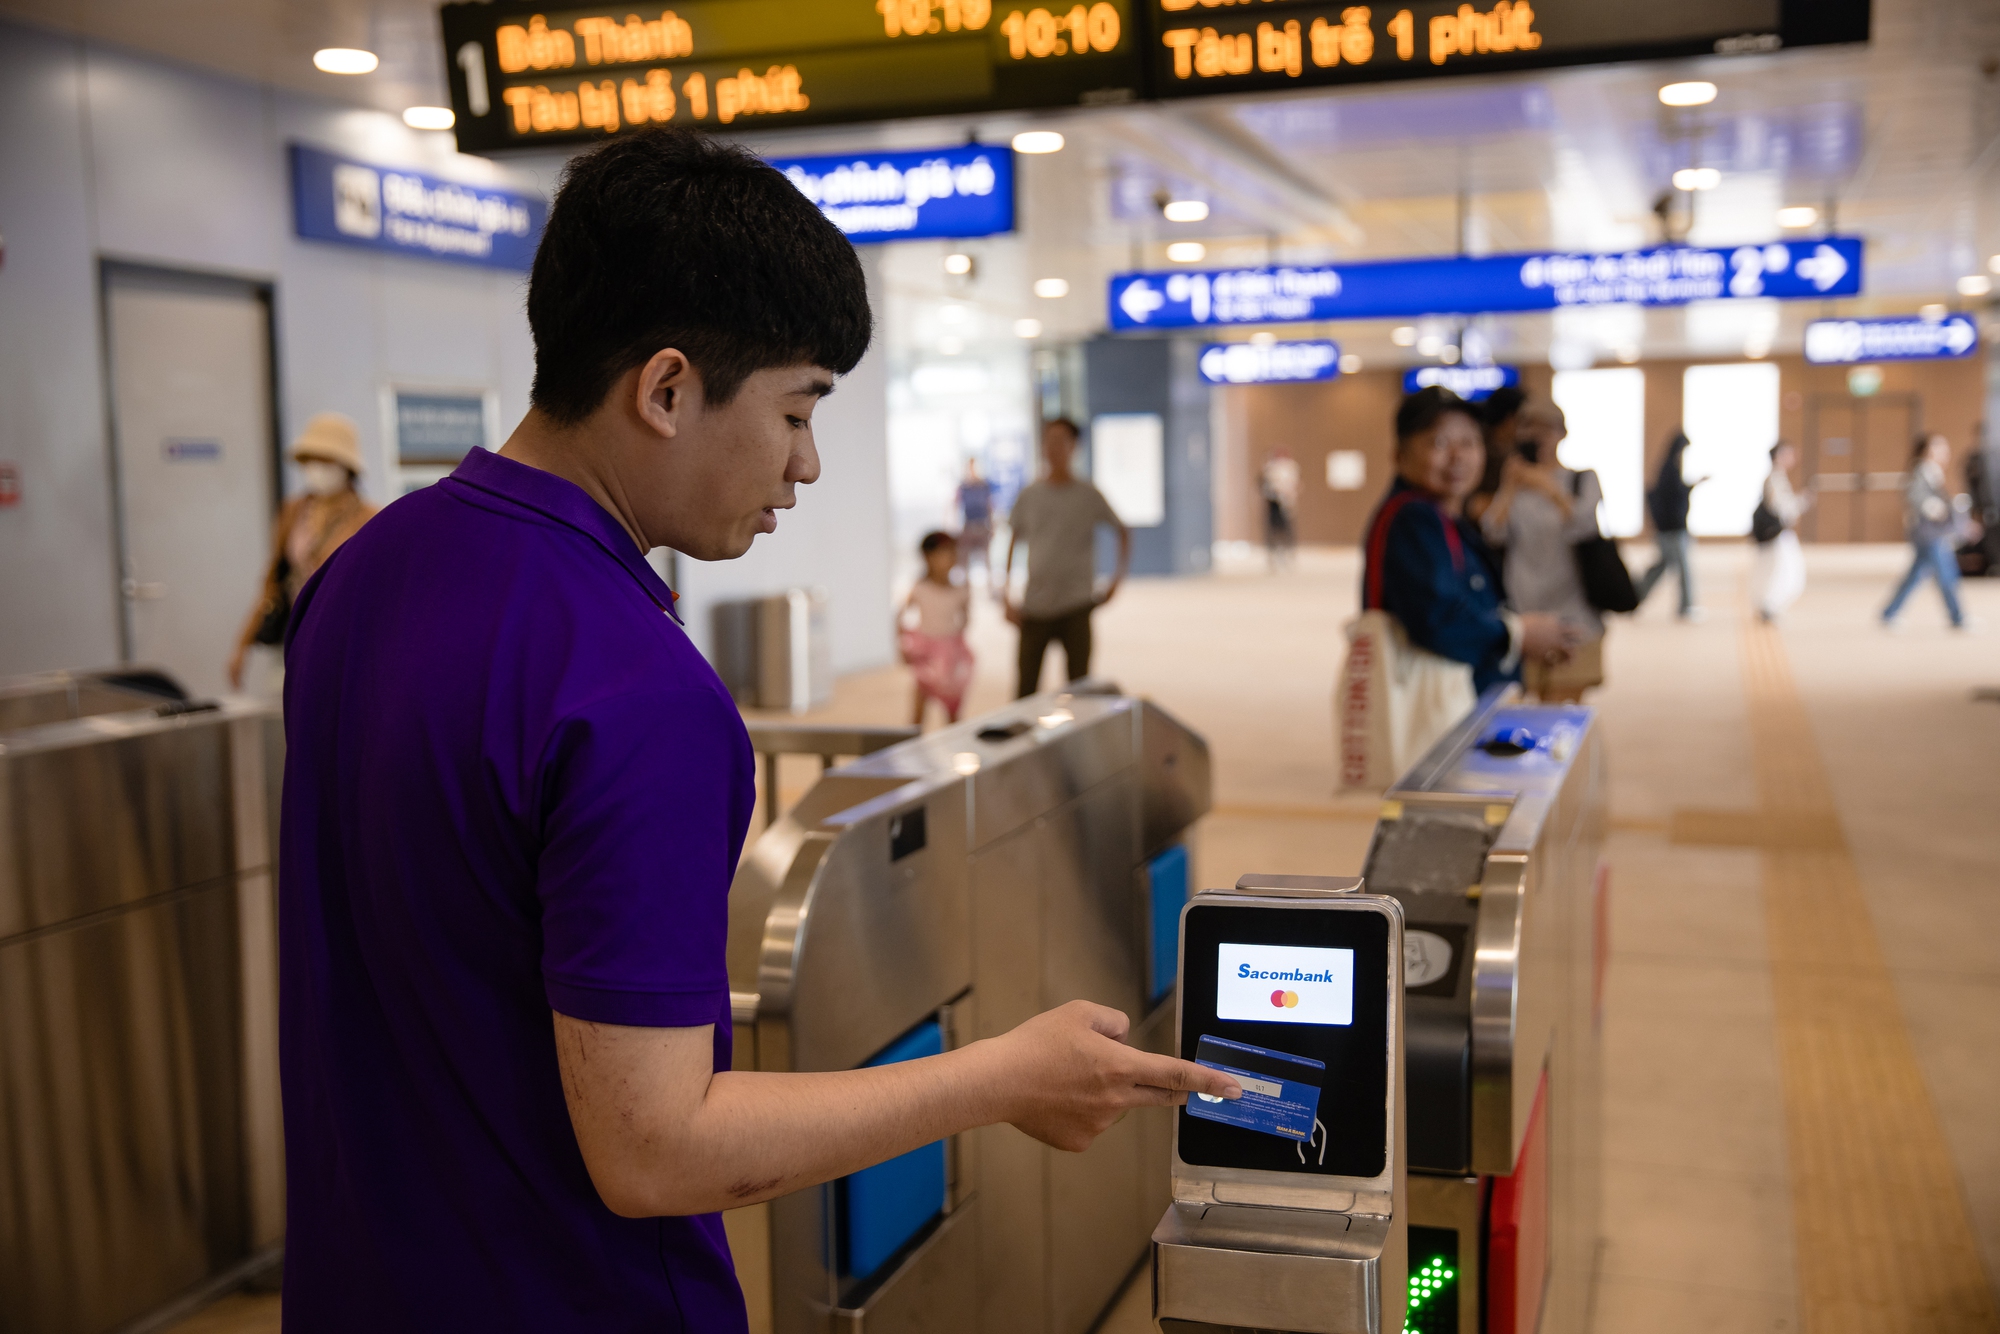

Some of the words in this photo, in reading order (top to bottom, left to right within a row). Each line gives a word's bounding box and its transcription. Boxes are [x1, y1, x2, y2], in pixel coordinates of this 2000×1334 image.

[496, 14, 575, 73] Bến
[1000, 2, 1120, 60] 10:10
[1162, 26, 1253, 79] Tàu
[1256, 19, 1302, 77] bị
[1387, 9, 1414, 60] 1
[457, 41, 490, 117] 1
[503, 85, 580, 133] Tàu
[578, 80, 621, 133] bị
[682, 72, 709, 120] 1
[1730, 245, 1765, 297] 2
[1238, 963, 1333, 983] Sacombank
